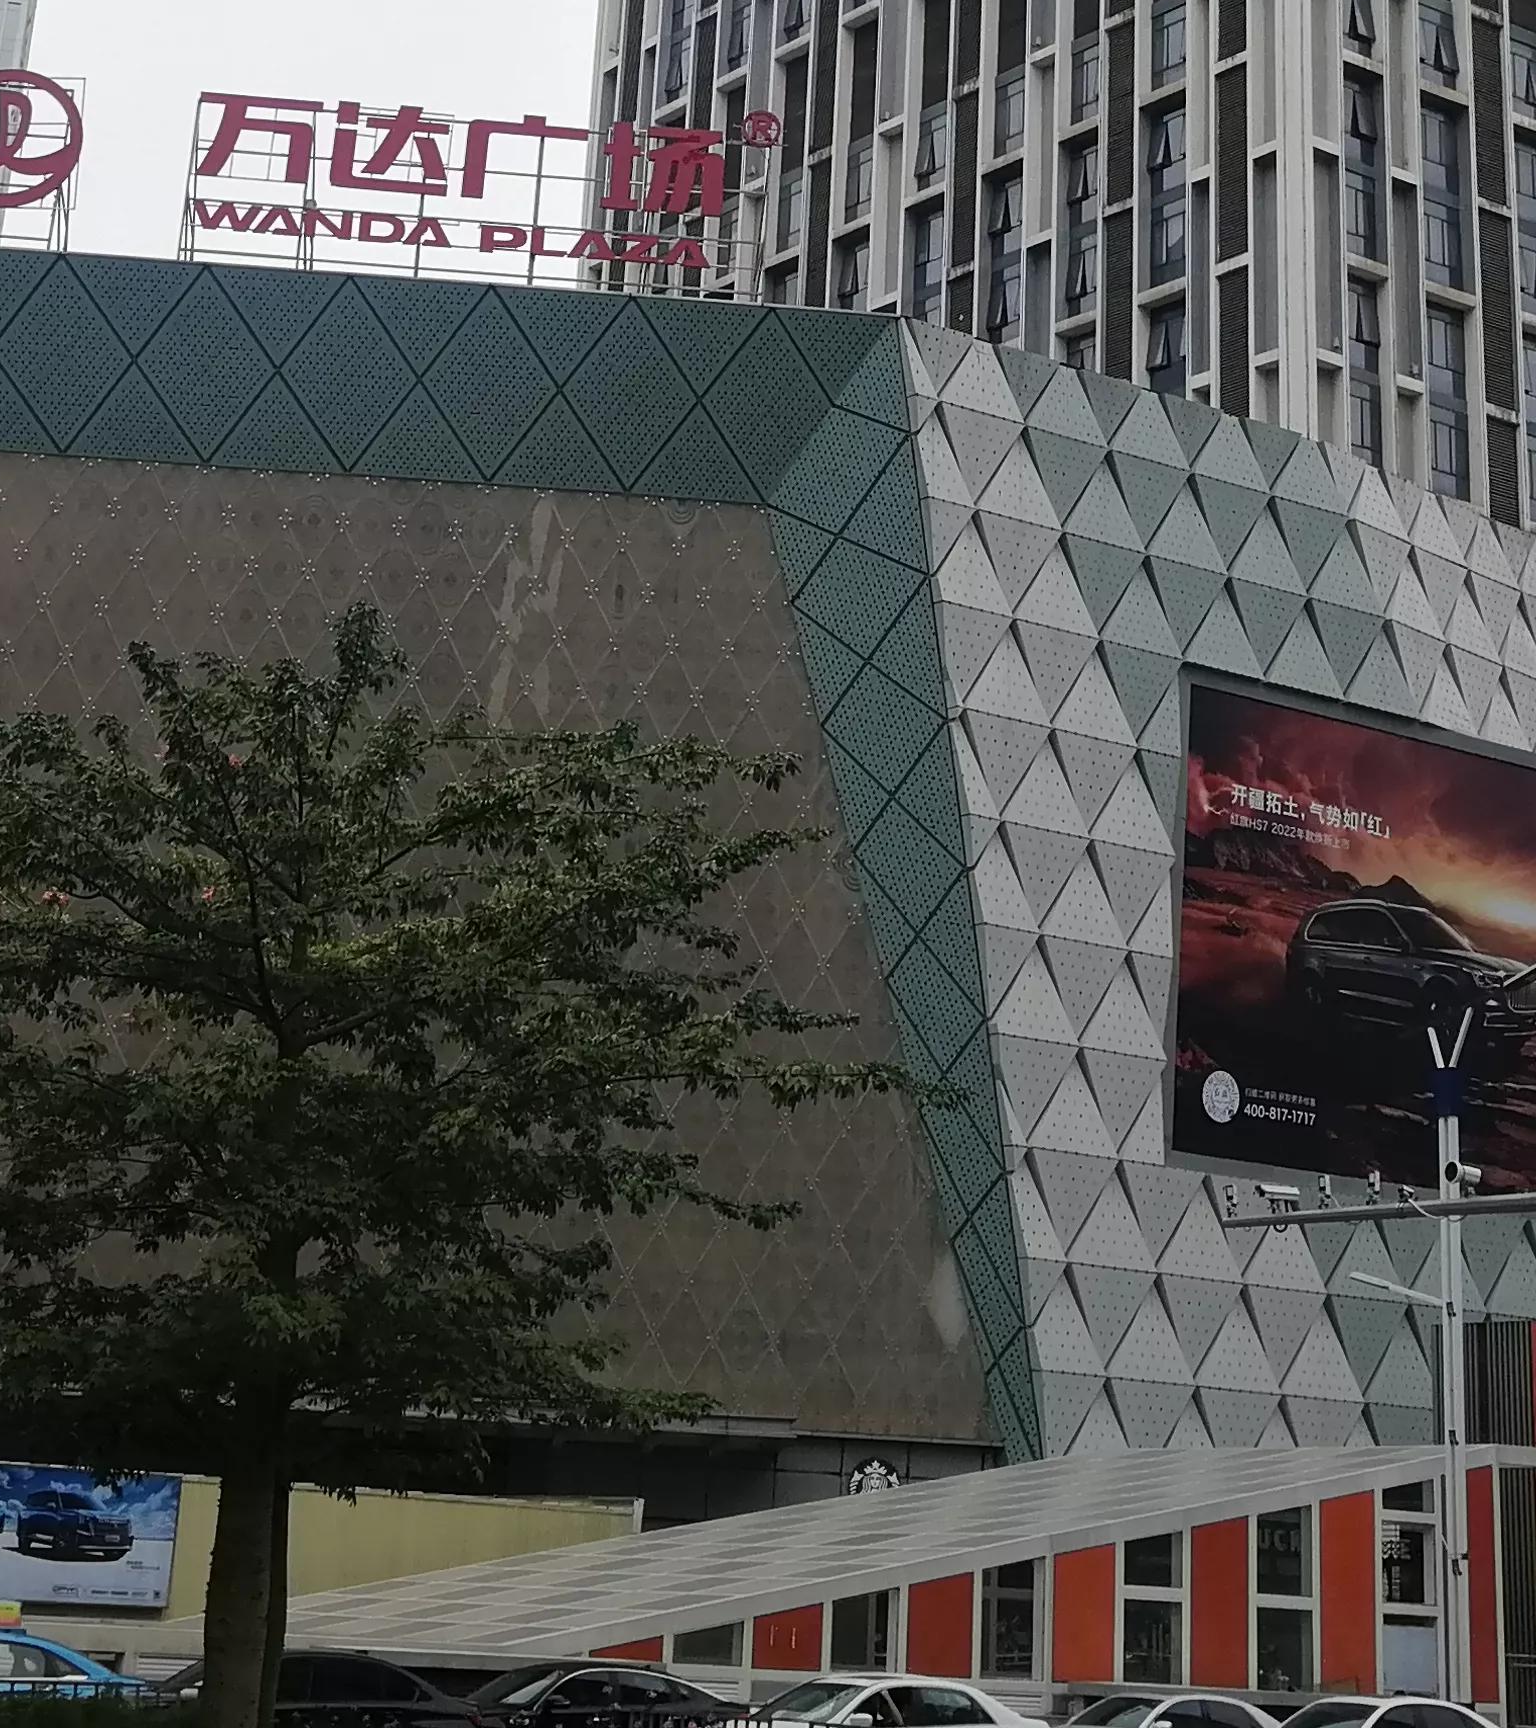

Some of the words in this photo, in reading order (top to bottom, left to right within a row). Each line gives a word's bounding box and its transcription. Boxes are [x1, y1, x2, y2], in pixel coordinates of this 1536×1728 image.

[194, 91, 726, 217] 万达广场
[193, 198, 452, 248] WANDA
[479, 223, 713, 269] PLAZA
[1244, 1103, 1316, 1126] 400-817-1717
